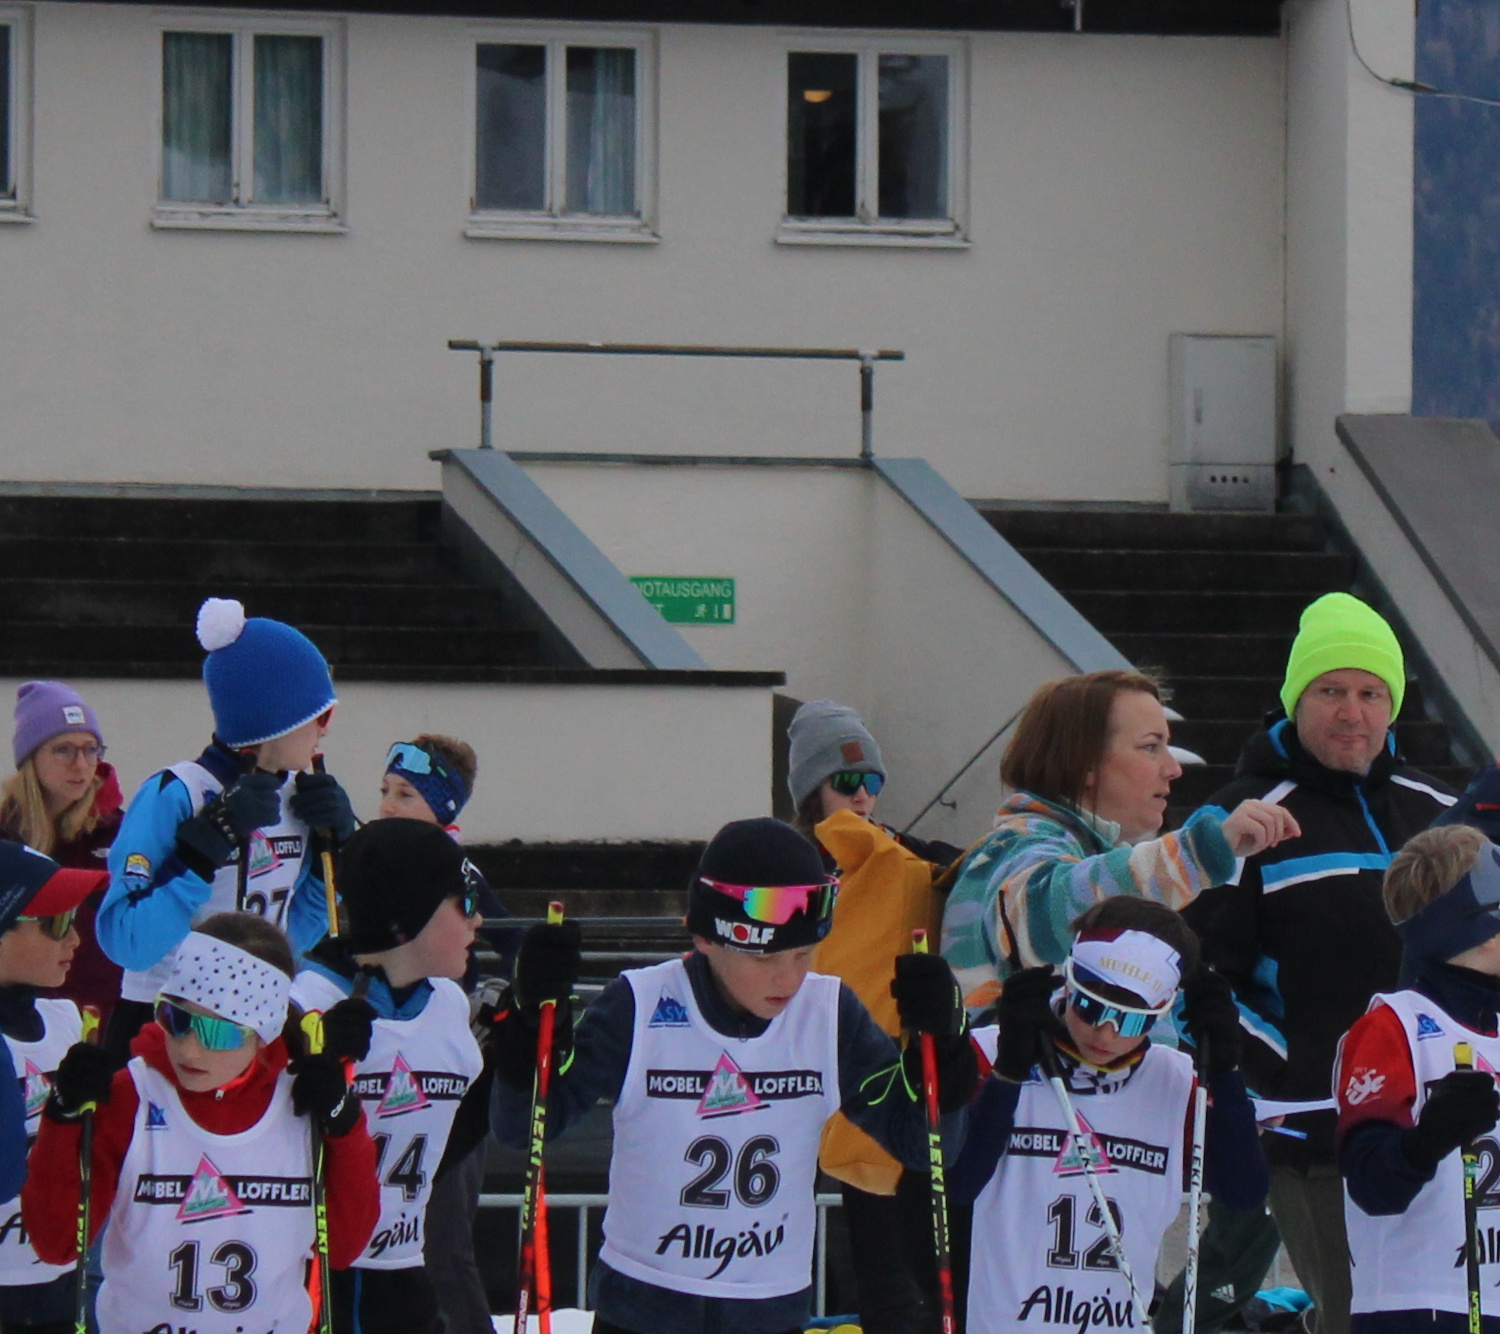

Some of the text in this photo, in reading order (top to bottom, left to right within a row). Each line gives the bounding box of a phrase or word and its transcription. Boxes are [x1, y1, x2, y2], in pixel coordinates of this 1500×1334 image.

[715, 918, 775, 945] WOLF
[530, 1105, 546, 1167] LEKI
[928, 1133, 943, 1193] LEKI
[1008, 1132, 1167, 1170] MÖBEL LÖFFLER
[237, 1180, 310, 1202] LÖFFLER
[373, 1133, 429, 1203] 14
[679, 1134, 780, 1209] 26
[1192, 1143, 1203, 1192] LEKI
[316, 1204, 329, 1255] LEKI
[654, 1221, 785, 1280] Allgäu
[1046, 1193, 1125, 1273] 12
[168, 1238, 258, 1314] 13
